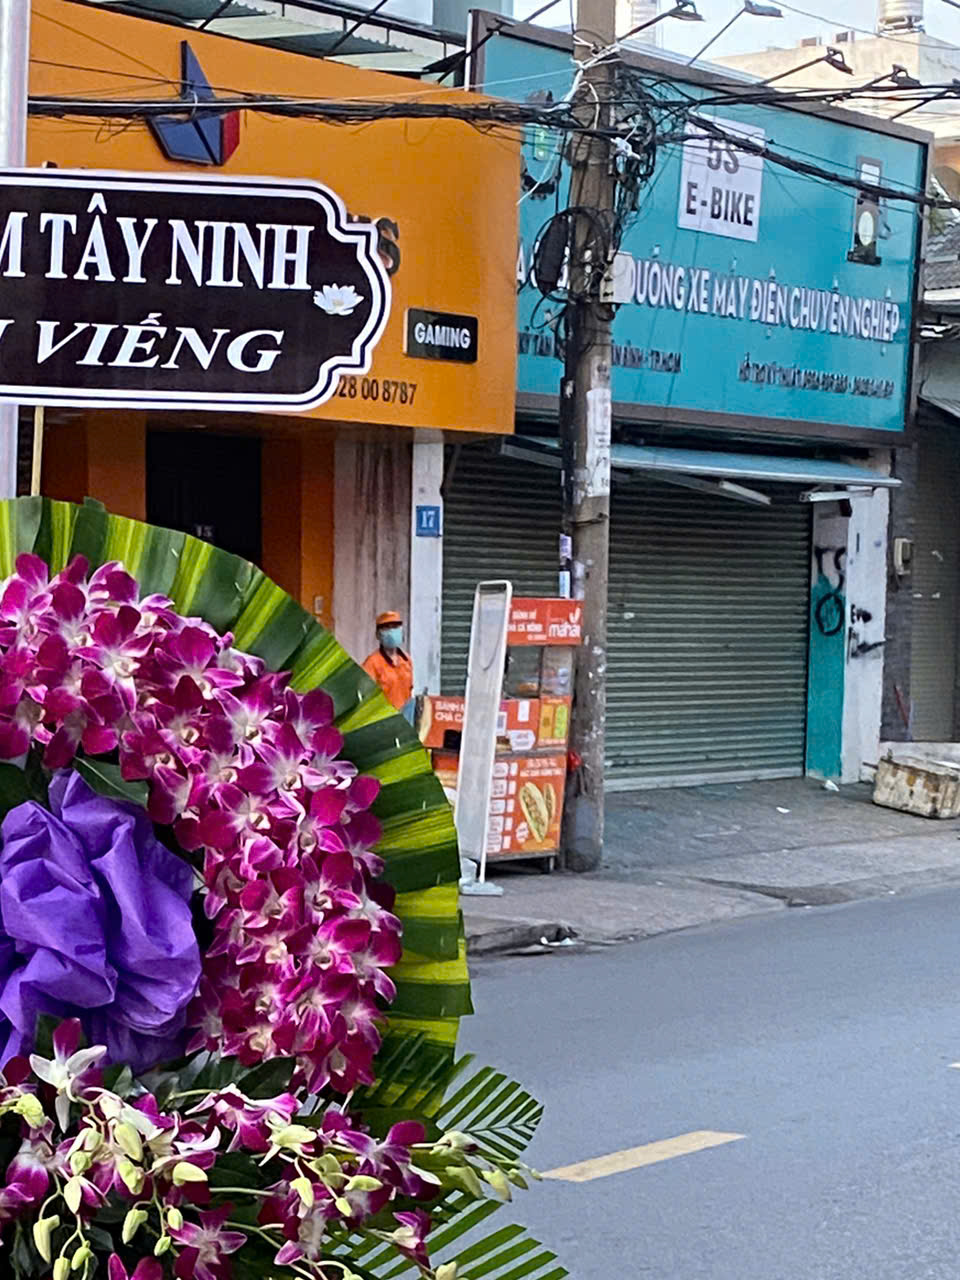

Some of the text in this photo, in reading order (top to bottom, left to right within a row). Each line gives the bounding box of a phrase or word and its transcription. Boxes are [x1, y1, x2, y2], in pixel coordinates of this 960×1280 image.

[39, 193, 156, 284] TÂY
[166, 218, 317, 291] NINH
[688, 267, 711, 313] XE
[34, 311, 286, 373] VIẾNG
[414, 322, 471, 349] GAMING
[332, 375, 417, 405] 28 00 8787
[421, 510, 436, 528] 17
